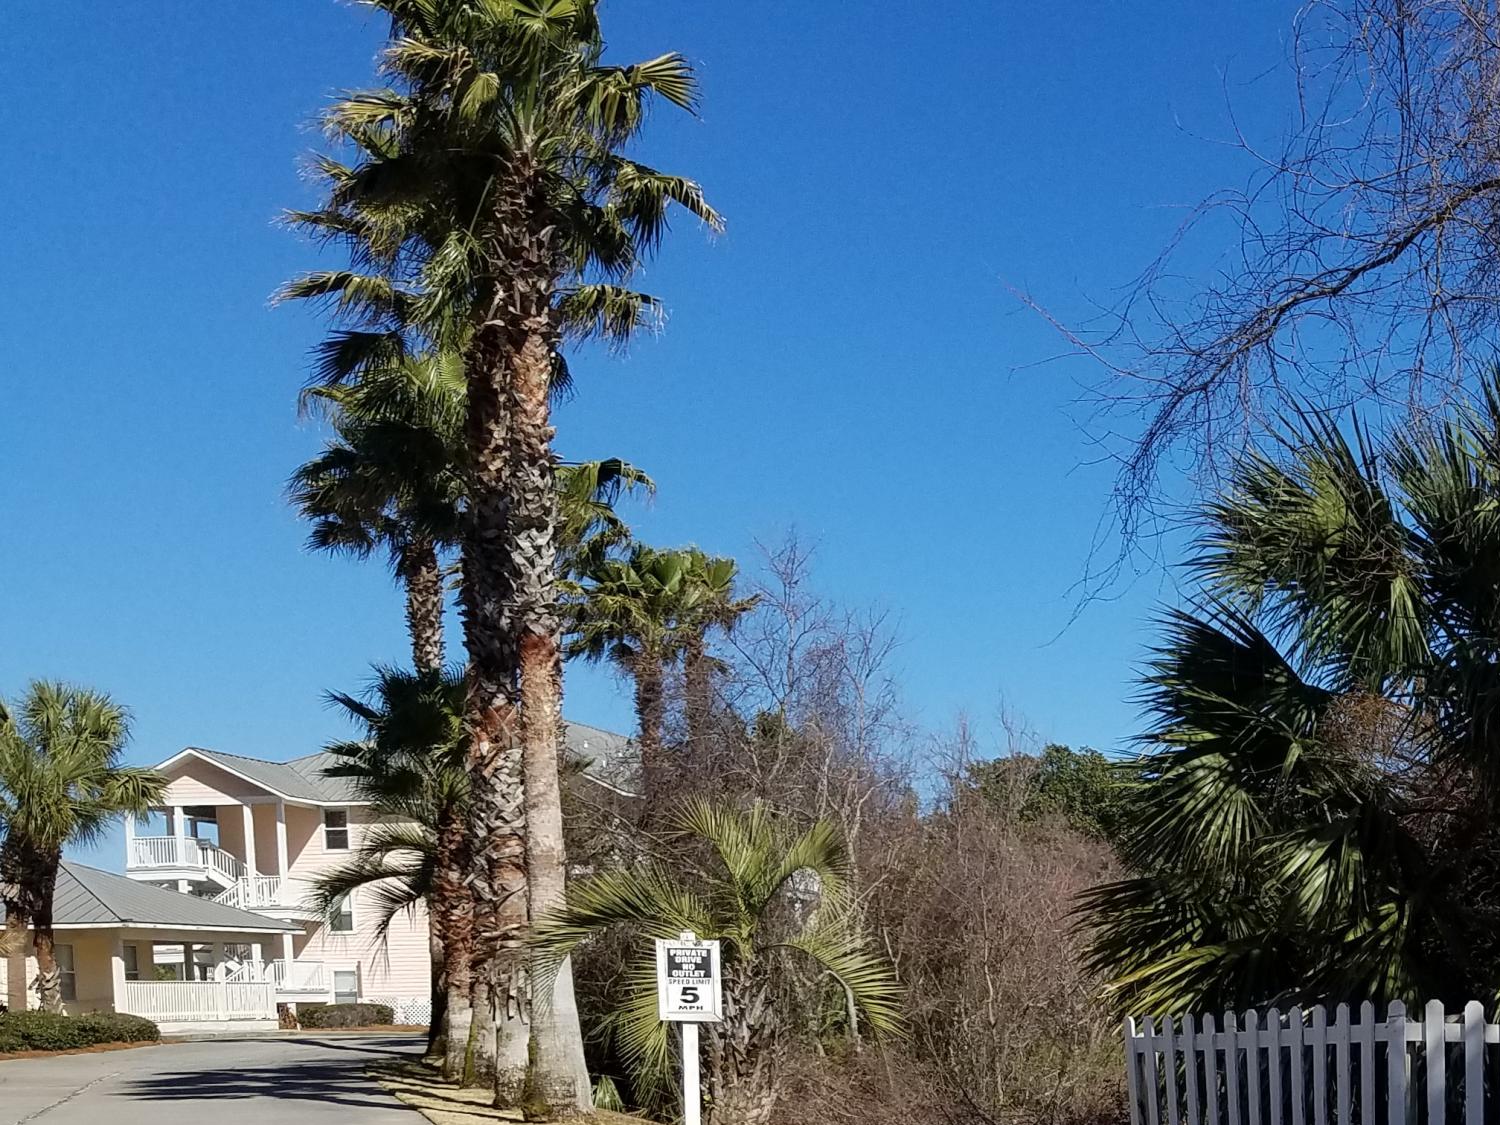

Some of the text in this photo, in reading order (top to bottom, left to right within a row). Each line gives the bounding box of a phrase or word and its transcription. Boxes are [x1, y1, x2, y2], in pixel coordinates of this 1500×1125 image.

[669, 949, 708, 957] PRIVATE
[674, 956, 702, 964] DRIVE
[682, 963, 696, 971] NO
[671, 970, 706, 978] OUTLET
[679, 986, 700, 1004] 5
